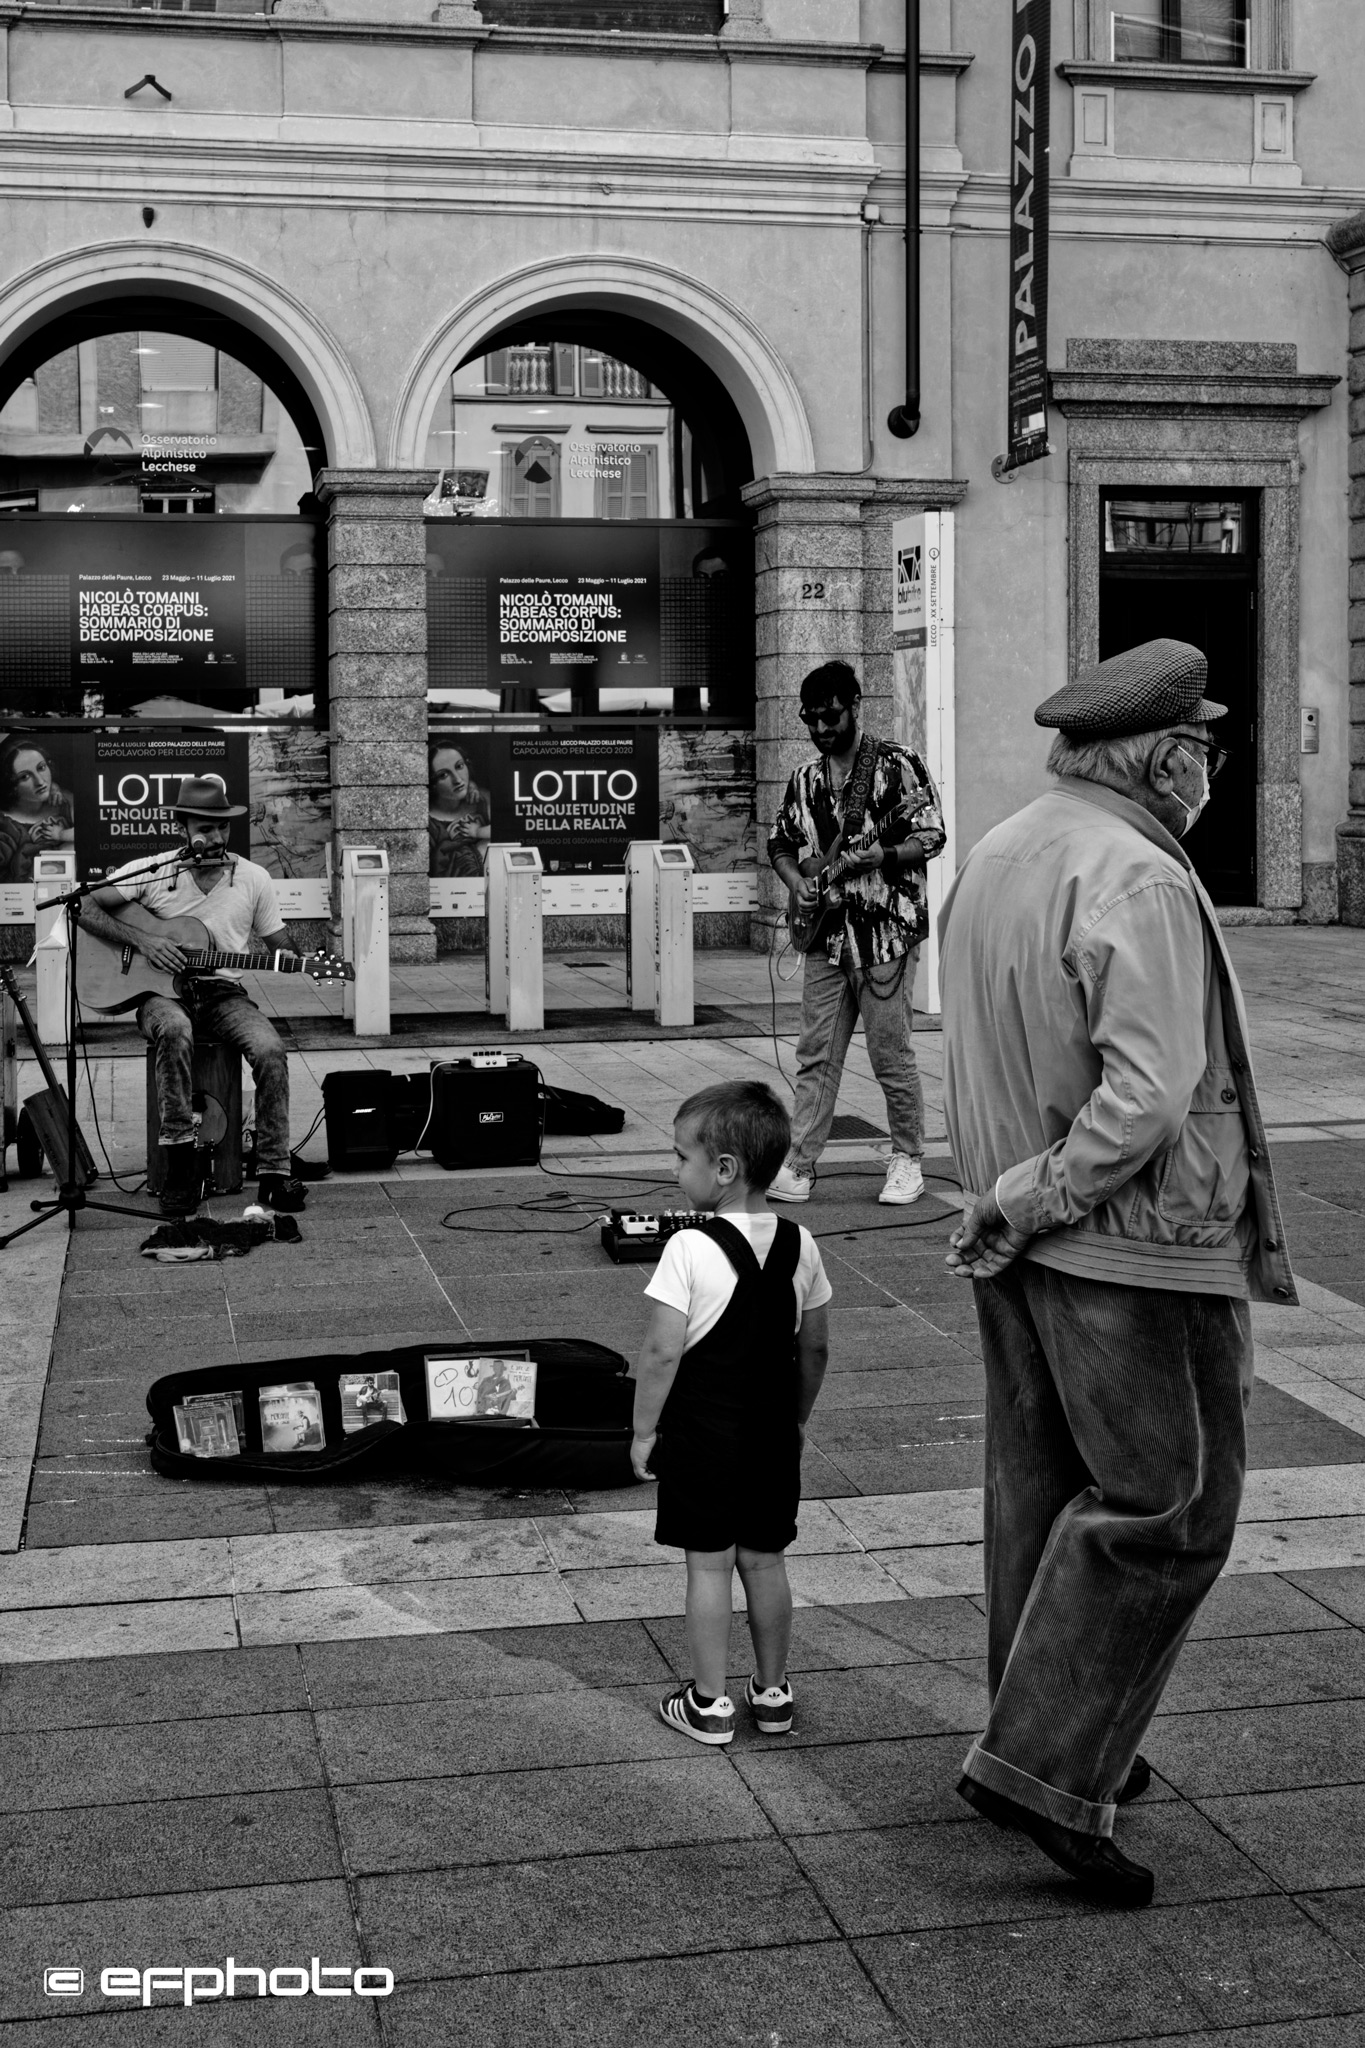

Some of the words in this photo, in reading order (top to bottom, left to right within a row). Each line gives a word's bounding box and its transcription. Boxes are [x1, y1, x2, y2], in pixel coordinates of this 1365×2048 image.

[1014, 33, 1038, 357] PALAZZO
[141, 434, 217, 445] Osservatorio
[569, 442, 641, 453] Osservatorio
[141, 448, 207, 460] Alpinistico
[141, 461, 196, 472] Lecchese
[569, 455, 632, 466] Alpinistico
[569, 468, 622, 478] Lecchese
[116, 574, 134, 582] Paure,
[170, 574, 191, 582] Maggio
[204, 574, 221, 582] Luglio
[585, 577, 604, 585] Maggio
[617, 577, 633, 585] Luglio
[79, 588, 134, 604] NICOLÒ
[136, 591, 199, 604] TOMAINI
[802, 583, 825, 599] 22
[499, 590, 552, 606] NICOLÒ
[554, 594, 613, 606] TOMAINI
[79, 604, 140, 617] HABEAS
[143, 604, 208, 617] CORPUS:
[500, 606, 557, 618] HABEAS
[560, 606, 621, 618] CORPUS:
[930, 607, 937, 618] XX
[79, 616, 162, 629] SOMMARIO
[166, 617, 180, 629] DI
[499, 618, 578, 630] SOMMARIO
[581, 618, 595, 630] DI
[80, 629, 214, 642] DECOMPOSIZIONE
[500, 630, 627, 643] DECOMPOSIZIONE
[98, 749, 156, 757] CAPOLAVORO
[205, 748, 225, 756] 2020
[513, 747, 568, 755] CAPOLAVORO
[514, 769, 637, 802] LOTTO
[515, 803, 635, 816] L'INQUIETUDINE
[525, 818, 570, 831] DELLA
[574, 815, 626, 830] REALTÀ
[111, 823, 157, 836] DELLA
[572, 837, 607, 845] GIOVANNI
[434, 1368, 458, 1387] CD
[444, 1386, 473, 1407] 10
